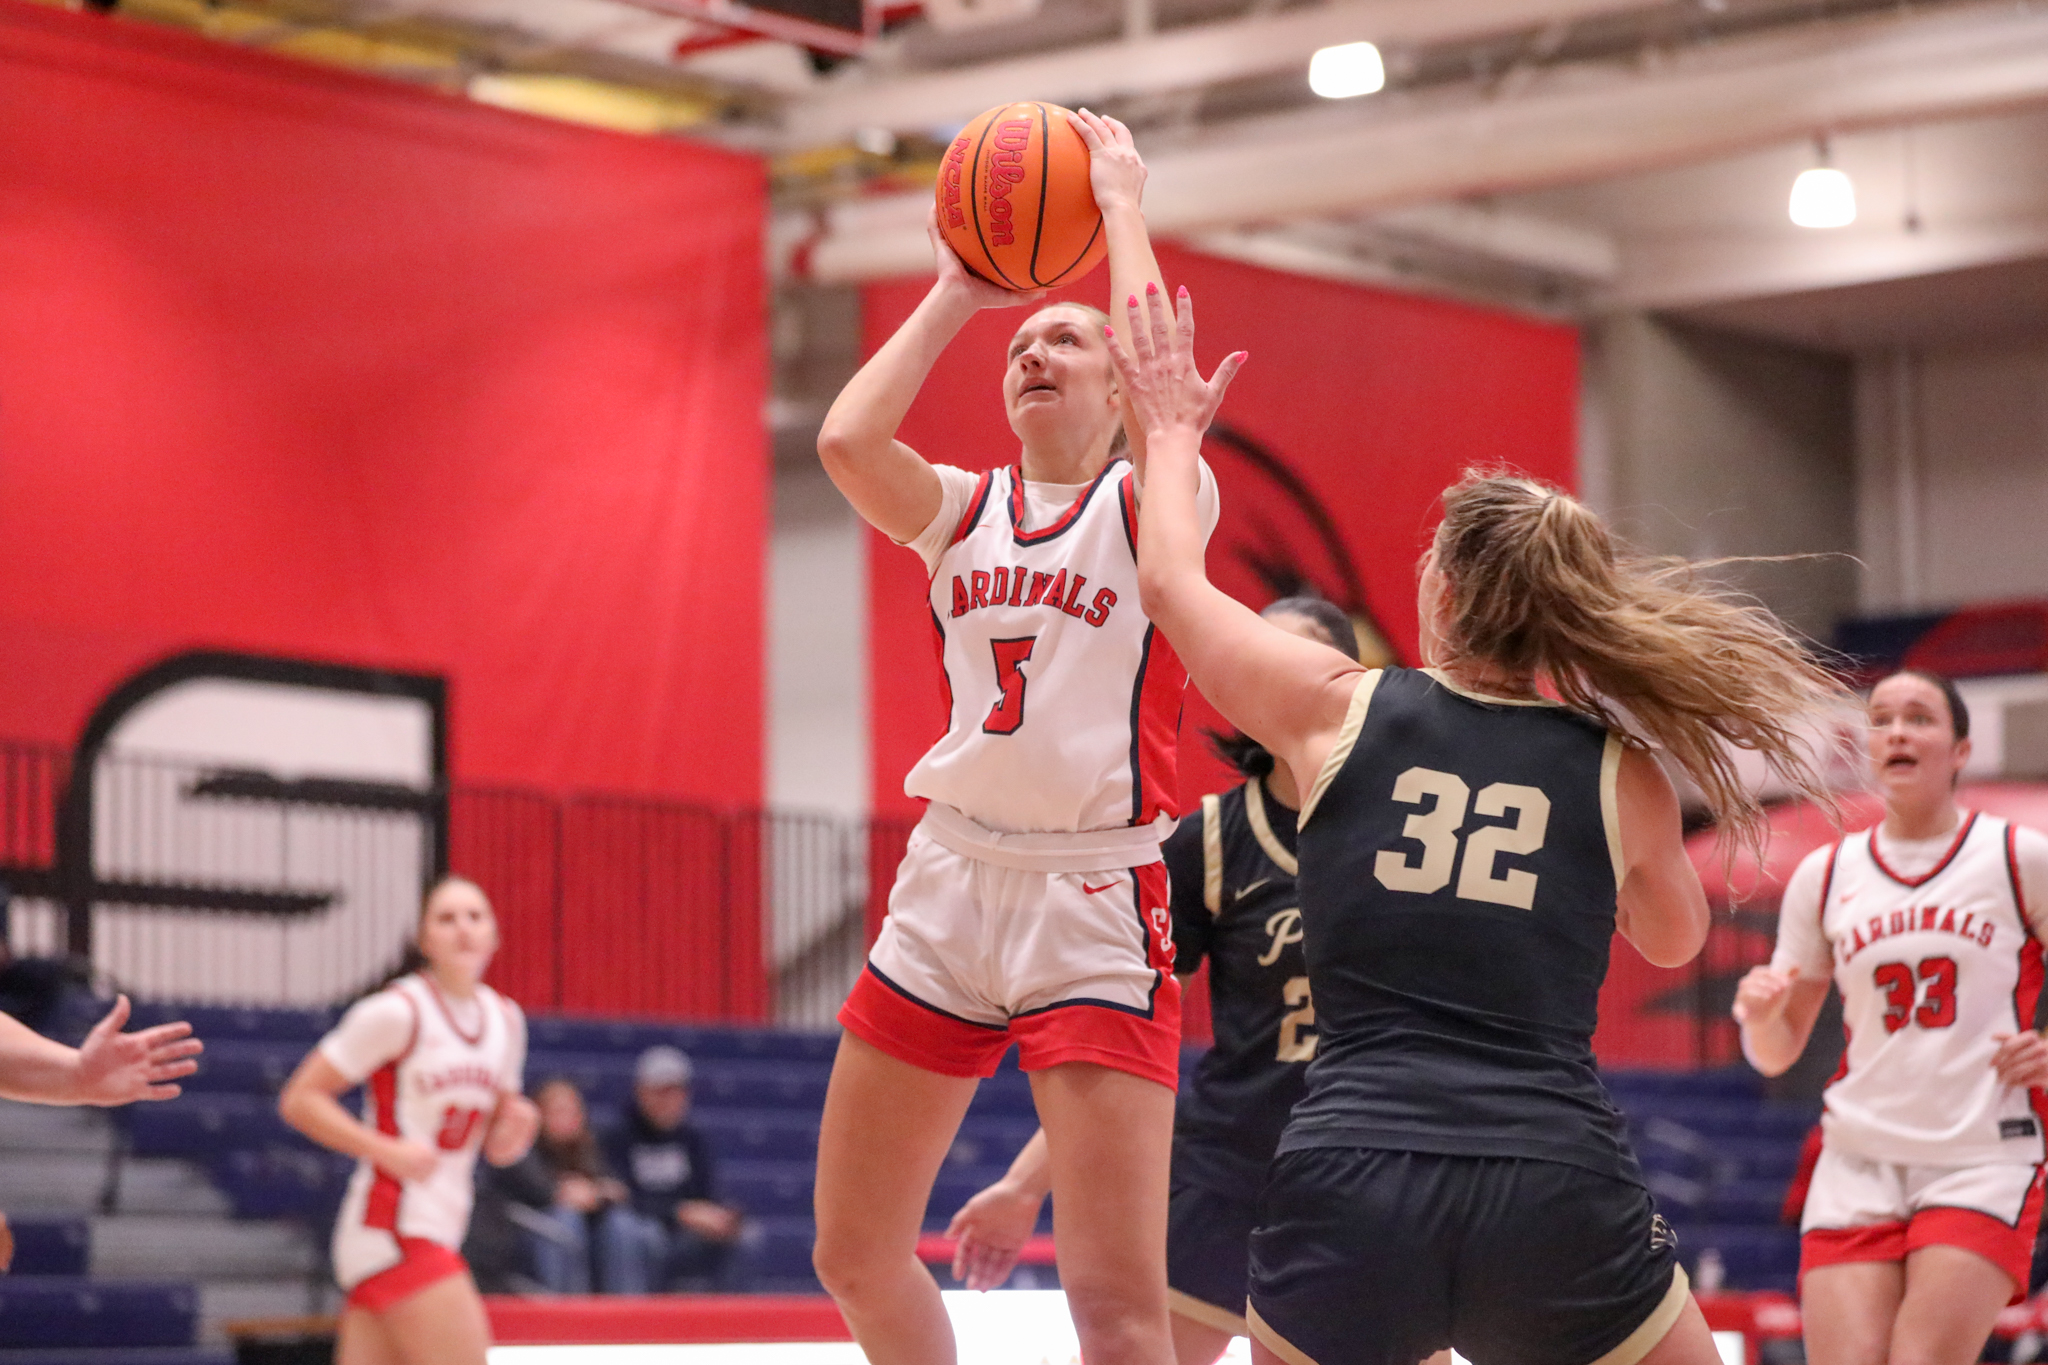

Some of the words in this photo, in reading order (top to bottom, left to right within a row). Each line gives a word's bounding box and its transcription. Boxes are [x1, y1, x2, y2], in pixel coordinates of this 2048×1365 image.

[944, 137, 971, 229] NCAA
[989, 118, 1034, 247] Wilson
[947, 566, 1118, 628] ARDINALS
[982, 635, 1037, 736] 5
[1373, 766, 1551, 911] 32
[1874, 956, 1957, 1035] 33
